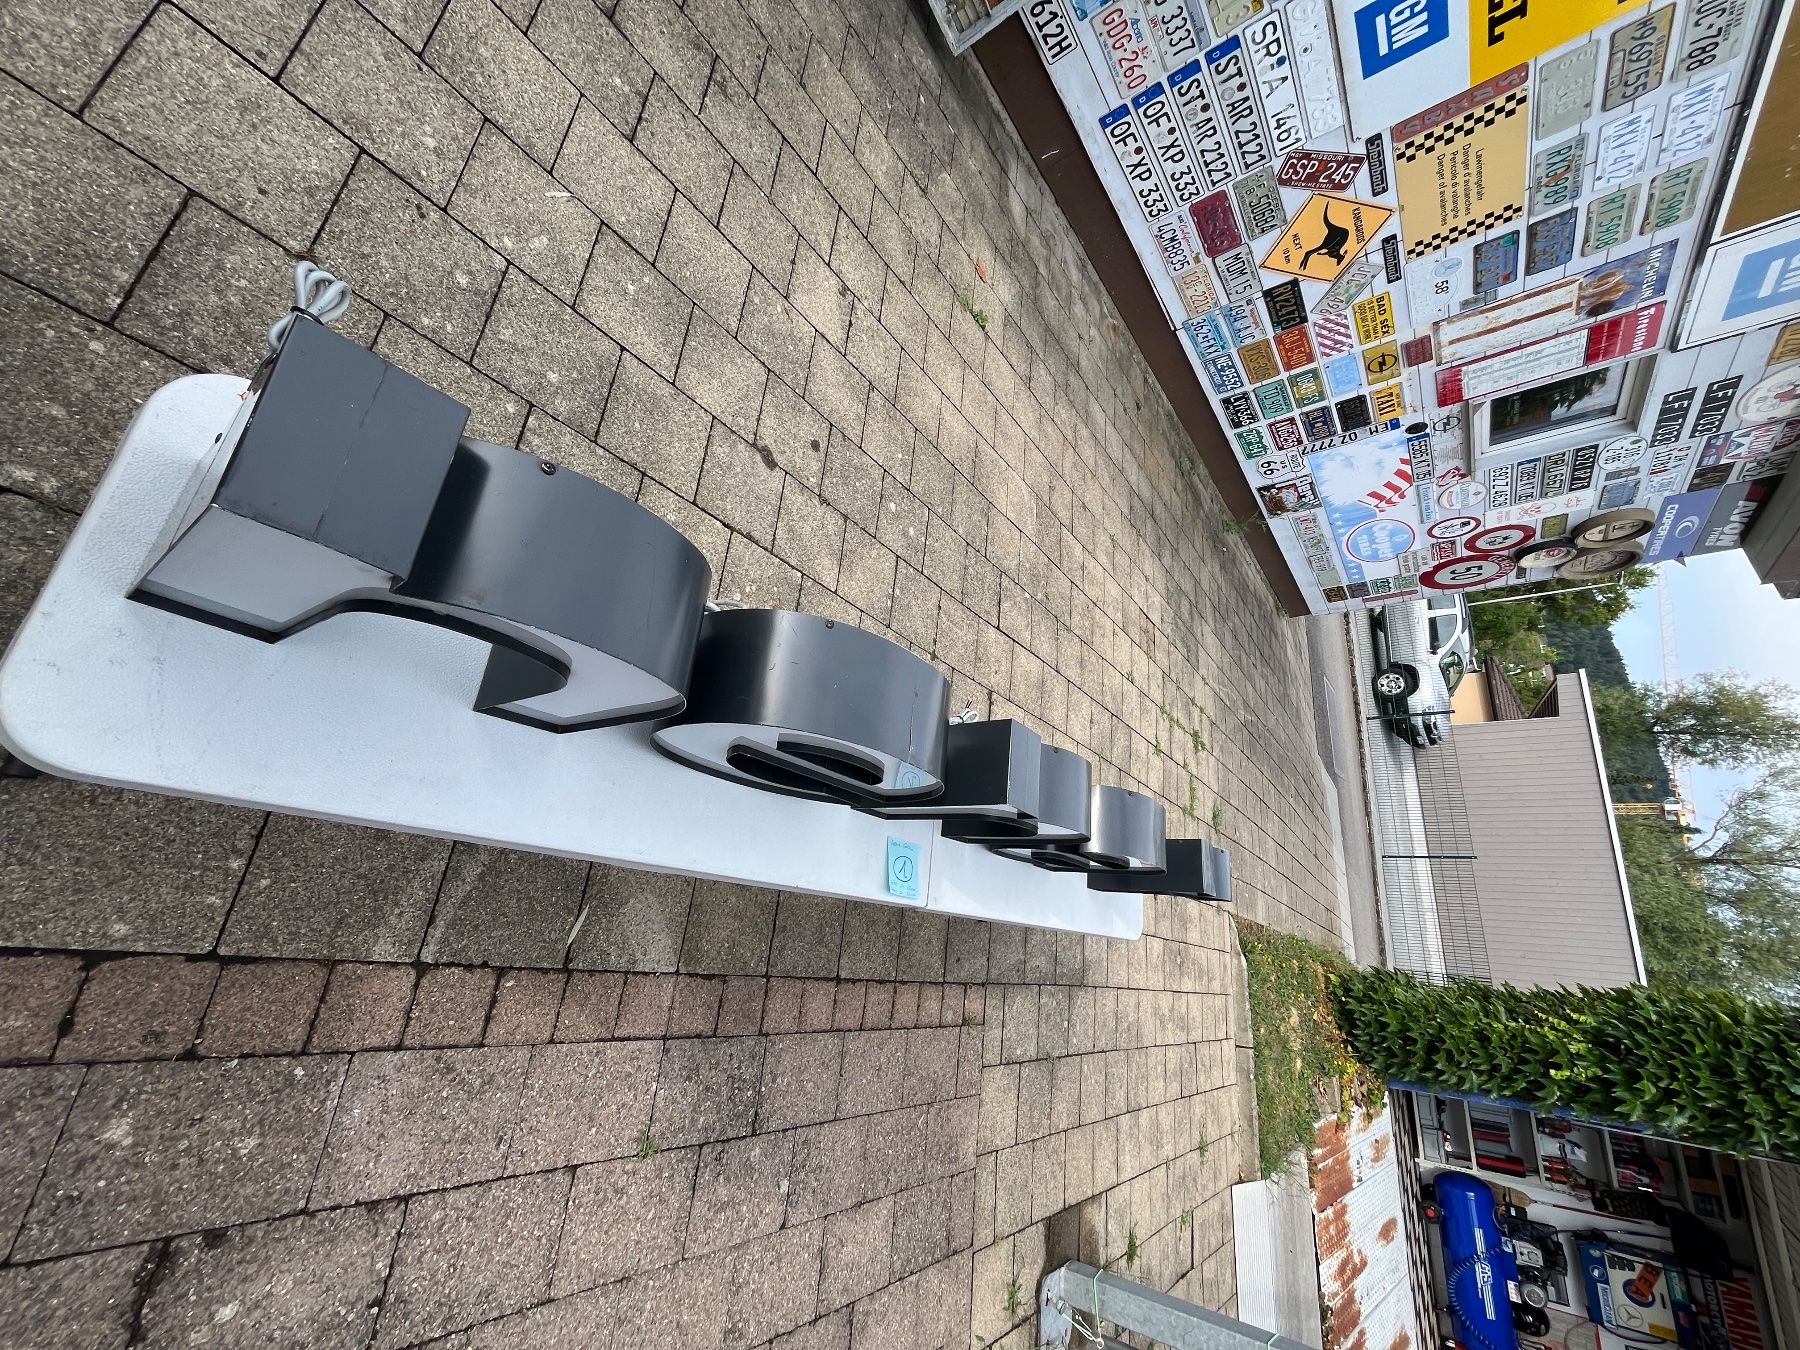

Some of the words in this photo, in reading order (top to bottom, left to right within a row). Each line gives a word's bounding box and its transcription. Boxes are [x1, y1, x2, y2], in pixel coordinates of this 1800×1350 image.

[1388, 0, 1429, 50] GM
[1214, 54, 1244, 85] ST
[1177, 78, 1206, 107] ST
[1261, 75, 1289, 99] A
[1143, 100, 1172, 129] OF
[1226, 96, 1254, 126] AR
[1109, 120, 1138, 147] OF
[1189, 117, 1218, 146] AR
[1271, 104, 1303, 153] 1461
[1158, 137, 1185, 163] XP
[1234, 121, 1267, 170] 2121
[1462, 142, 1472, 169] Danger
[1126, 156, 1153, 182] XP
[1201, 141, 1233, 187] 2121
[1281, 159, 1318, 181] GSP
[1318, 162, 1360, 184] 245
[1436, 153, 1446, 181] Danger
[1450, 150, 1461, 181] Pericolo
[1475, 147, 1486, 202] Lawinengefahr
[1545, 145, 1573, 178] RXG
[1170, 165, 1201, 203] 333
[1543, 176, 1570, 206] 989
[1663, 168, 1693, 187] RT
[1139, 182, 1169, 218] 333
[1439, 190, 1448, 227] avalanches
[1452, 189, 1462, 220] valanghe
[1600, 193, 1627, 211] RT
[1654, 191, 1687, 229] 5908
[1292, 232, 1303, 251] NEXT
[1594, 212, 1624, 250] 5908
[1157, 221, 1191, 272] 4CMB835
[1283, 247, 1288, 255] 10
[1285, 255, 1292, 265] km
[1222, 251, 1249, 282] MDM
[1639, 246, 1664, 299] MICHELIN
[1231, 283, 1253, 295] 15
[1271, 283, 1300, 328] RV2473
[1376, 296, 1387, 316] BAD
[1380, 319, 1391, 337] SEX
[1376, 391, 1397, 417] TAXI
[1301, 438, 1337, 456] 7777
[1260, 459, 1280, 477] 66
[1279, 459, 1288, 470] US
[1704, 526, 1723, 547] TYRES
[1715, 500, 1760, 547] AVON
[1371, 524, 1394, 559] Cooper
[1449, 564, 1484, 581] 50
